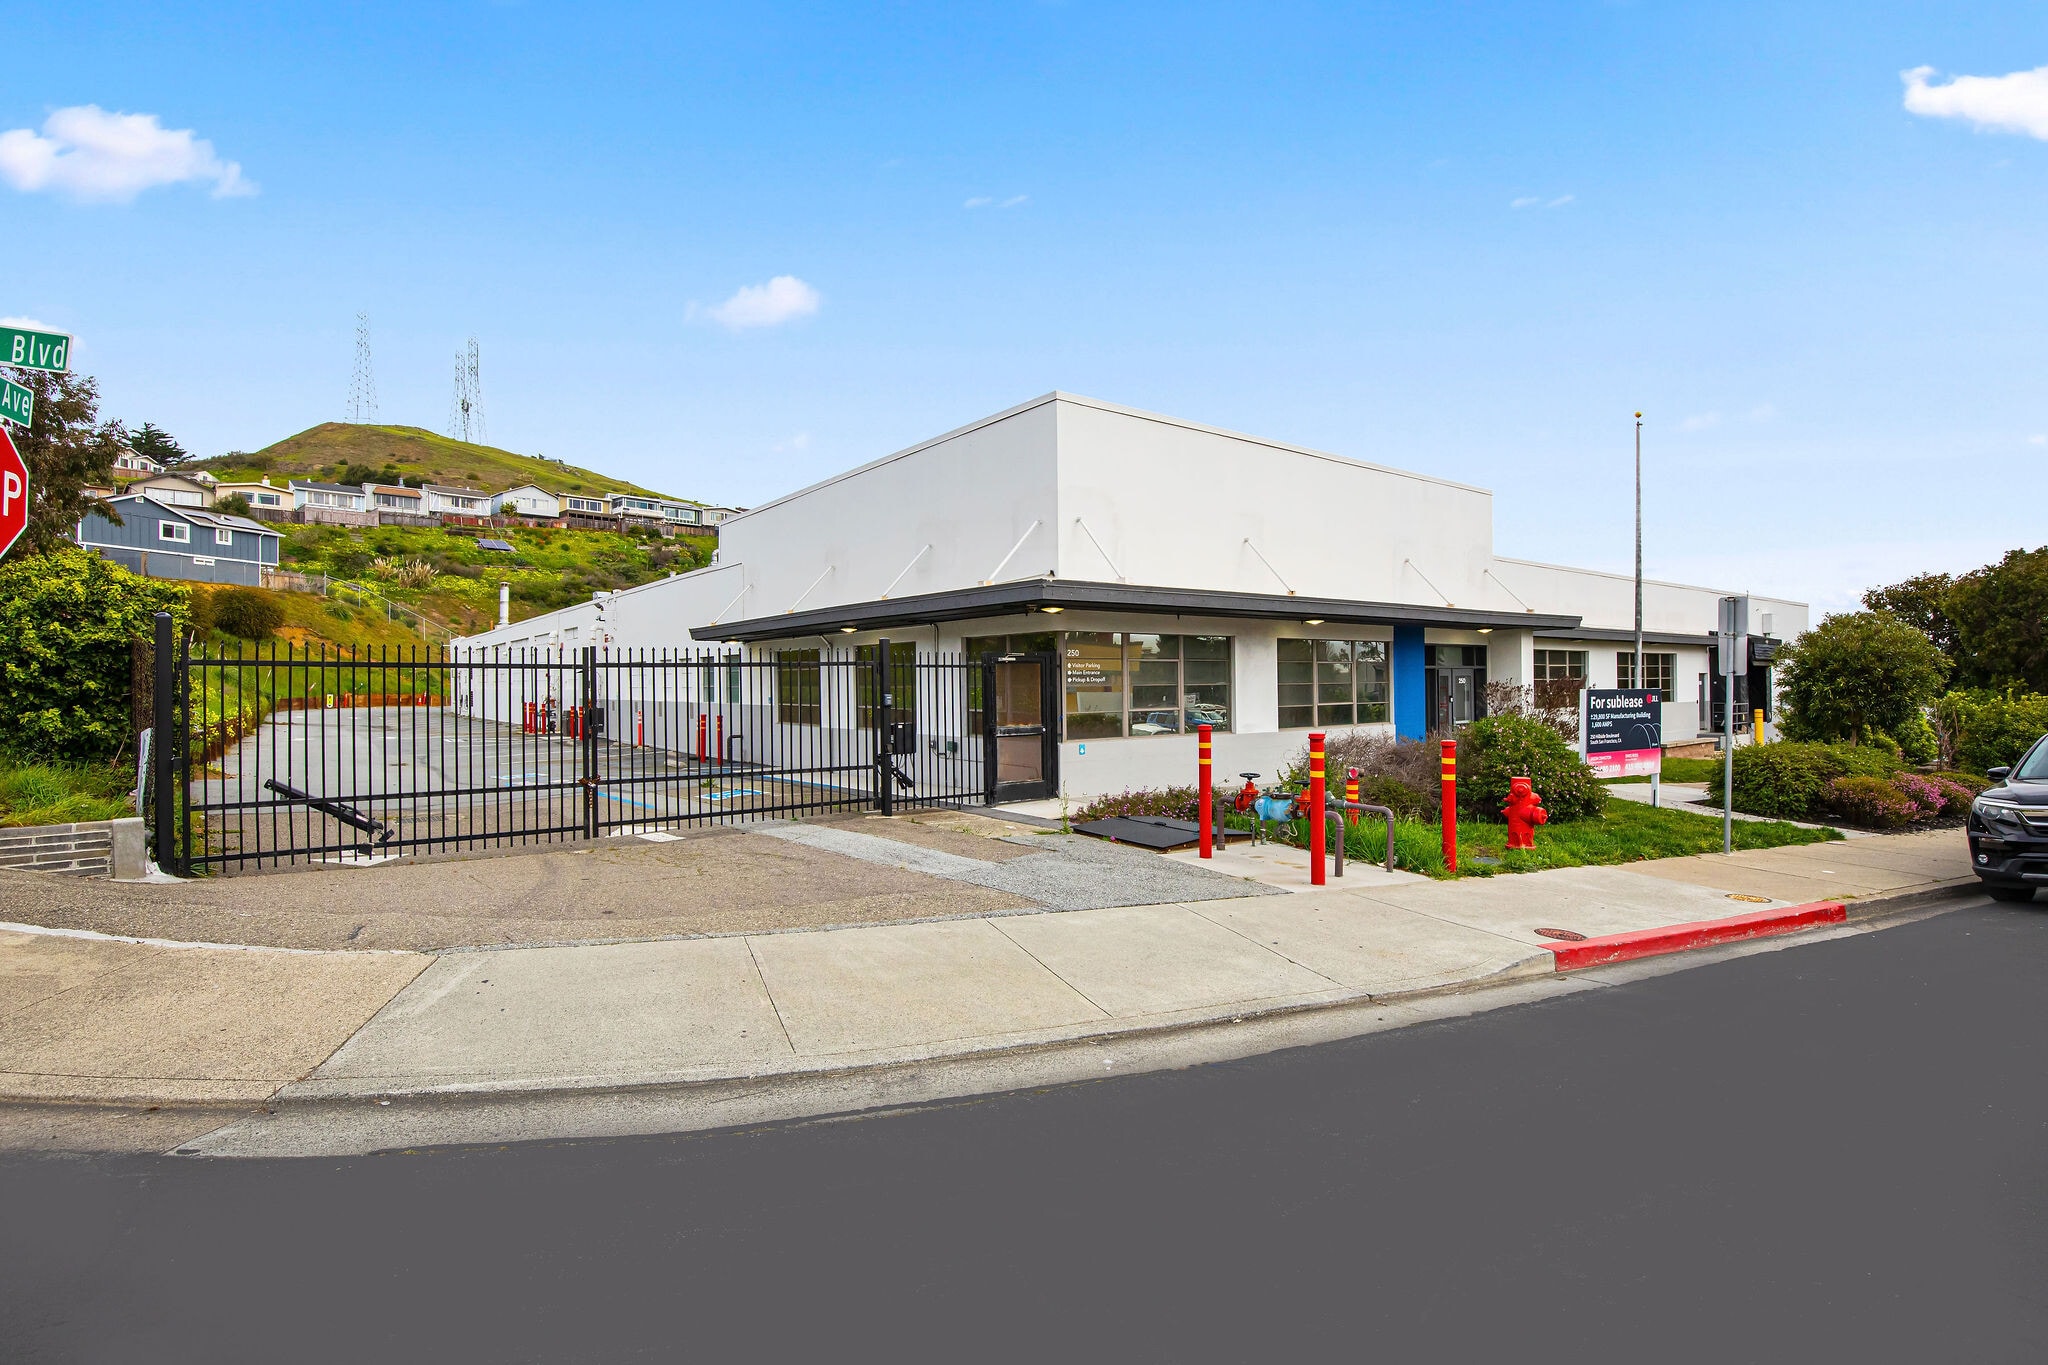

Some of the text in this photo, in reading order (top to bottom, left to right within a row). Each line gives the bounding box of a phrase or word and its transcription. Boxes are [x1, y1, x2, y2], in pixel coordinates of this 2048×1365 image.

[12, 335, 67, 369] Blvd
[2, 383, 30, 417] Ave
[1067, 649, 1080, 657] 250
[1590, 694, 1643, 709] For sublease
[1611, 712, 1636, 720] Manufacturing
[1636, 711, 1651, 719] Building
[1602, 720, 1613, 728] AMPS
